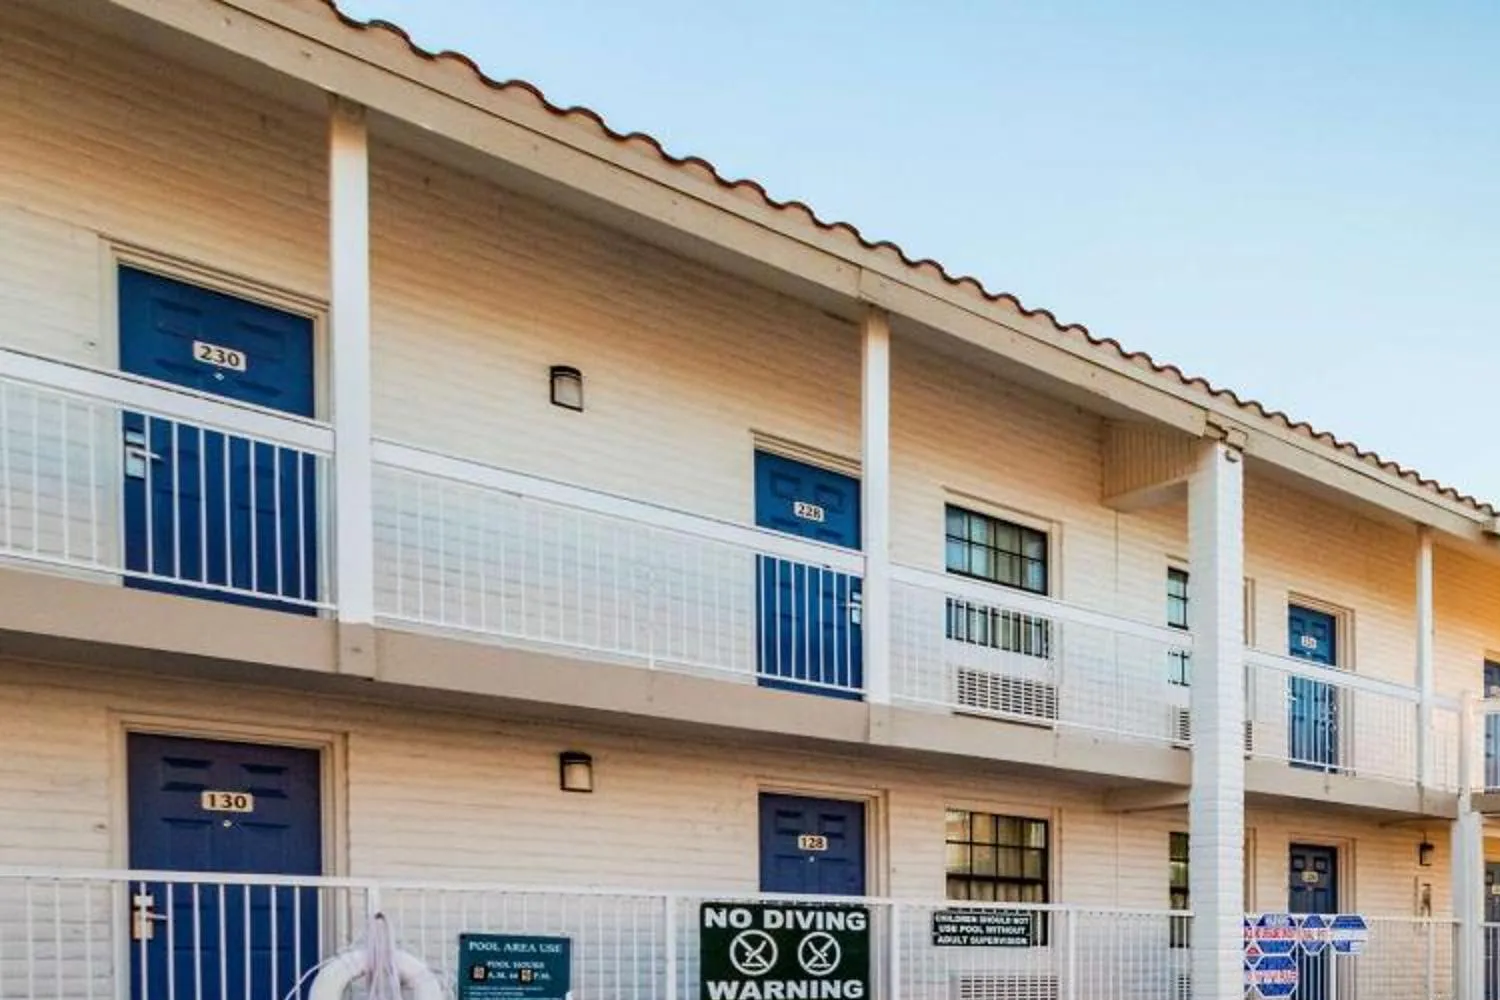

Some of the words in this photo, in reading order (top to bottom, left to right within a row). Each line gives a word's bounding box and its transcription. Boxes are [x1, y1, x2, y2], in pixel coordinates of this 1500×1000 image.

[200, 345, 240, 367] 230
[207, 793, 248, 809] 130
[801, 837, 824, 849] 128
[704, 907, 753, 929] NO
[763, 909, 867, 931] DIVING
[959, 925, 984, 933] POOL
[985, 926, 1026, 934] WITHOUT
[469, 941, 500, 952] POOL
[503, 943, 537, 953] AREA
[937, 936, 968, 944] ADULT
[706, 979, 864, 1000] WARNING
